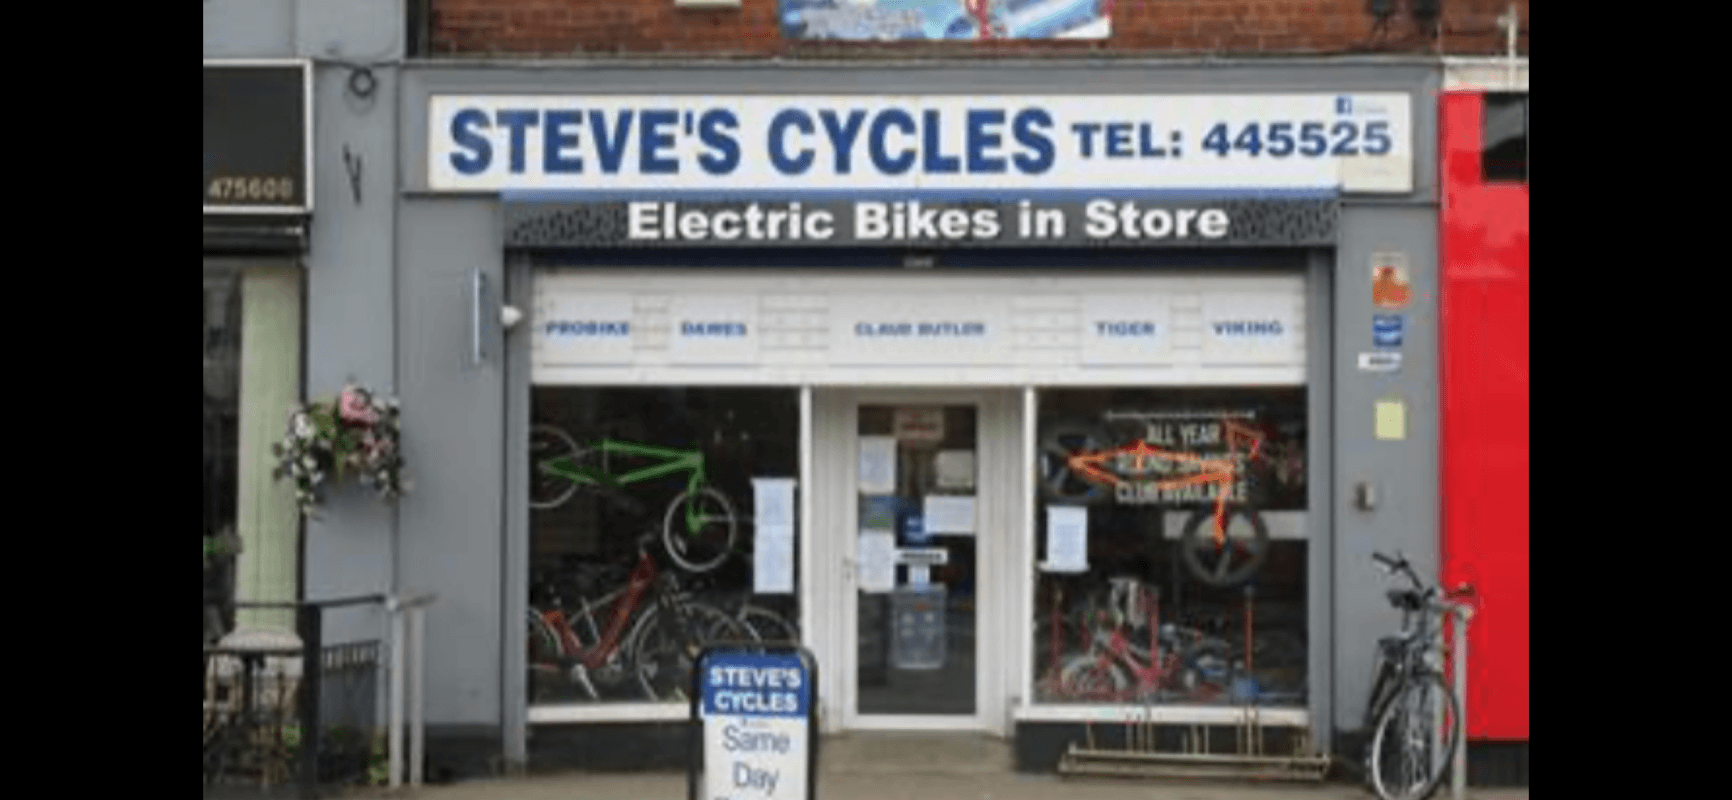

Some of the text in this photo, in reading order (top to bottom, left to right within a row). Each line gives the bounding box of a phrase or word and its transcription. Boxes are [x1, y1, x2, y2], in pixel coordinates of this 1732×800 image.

[449, 107, 1393, 176] STEVE'S CYCLES TEL: 445525
[628, 200, 1230, 240] Electric Bikes in Store
[1095, 321, 1156, 337] TIGER
[1212, 320, 1284, 337] VIKING
[710, 666, 801, 688] STEVE'S
[714, 690, 798, 712] CYCLES
[722, 725, 791, 755] Same
[732, 761, 780, 796] Day
